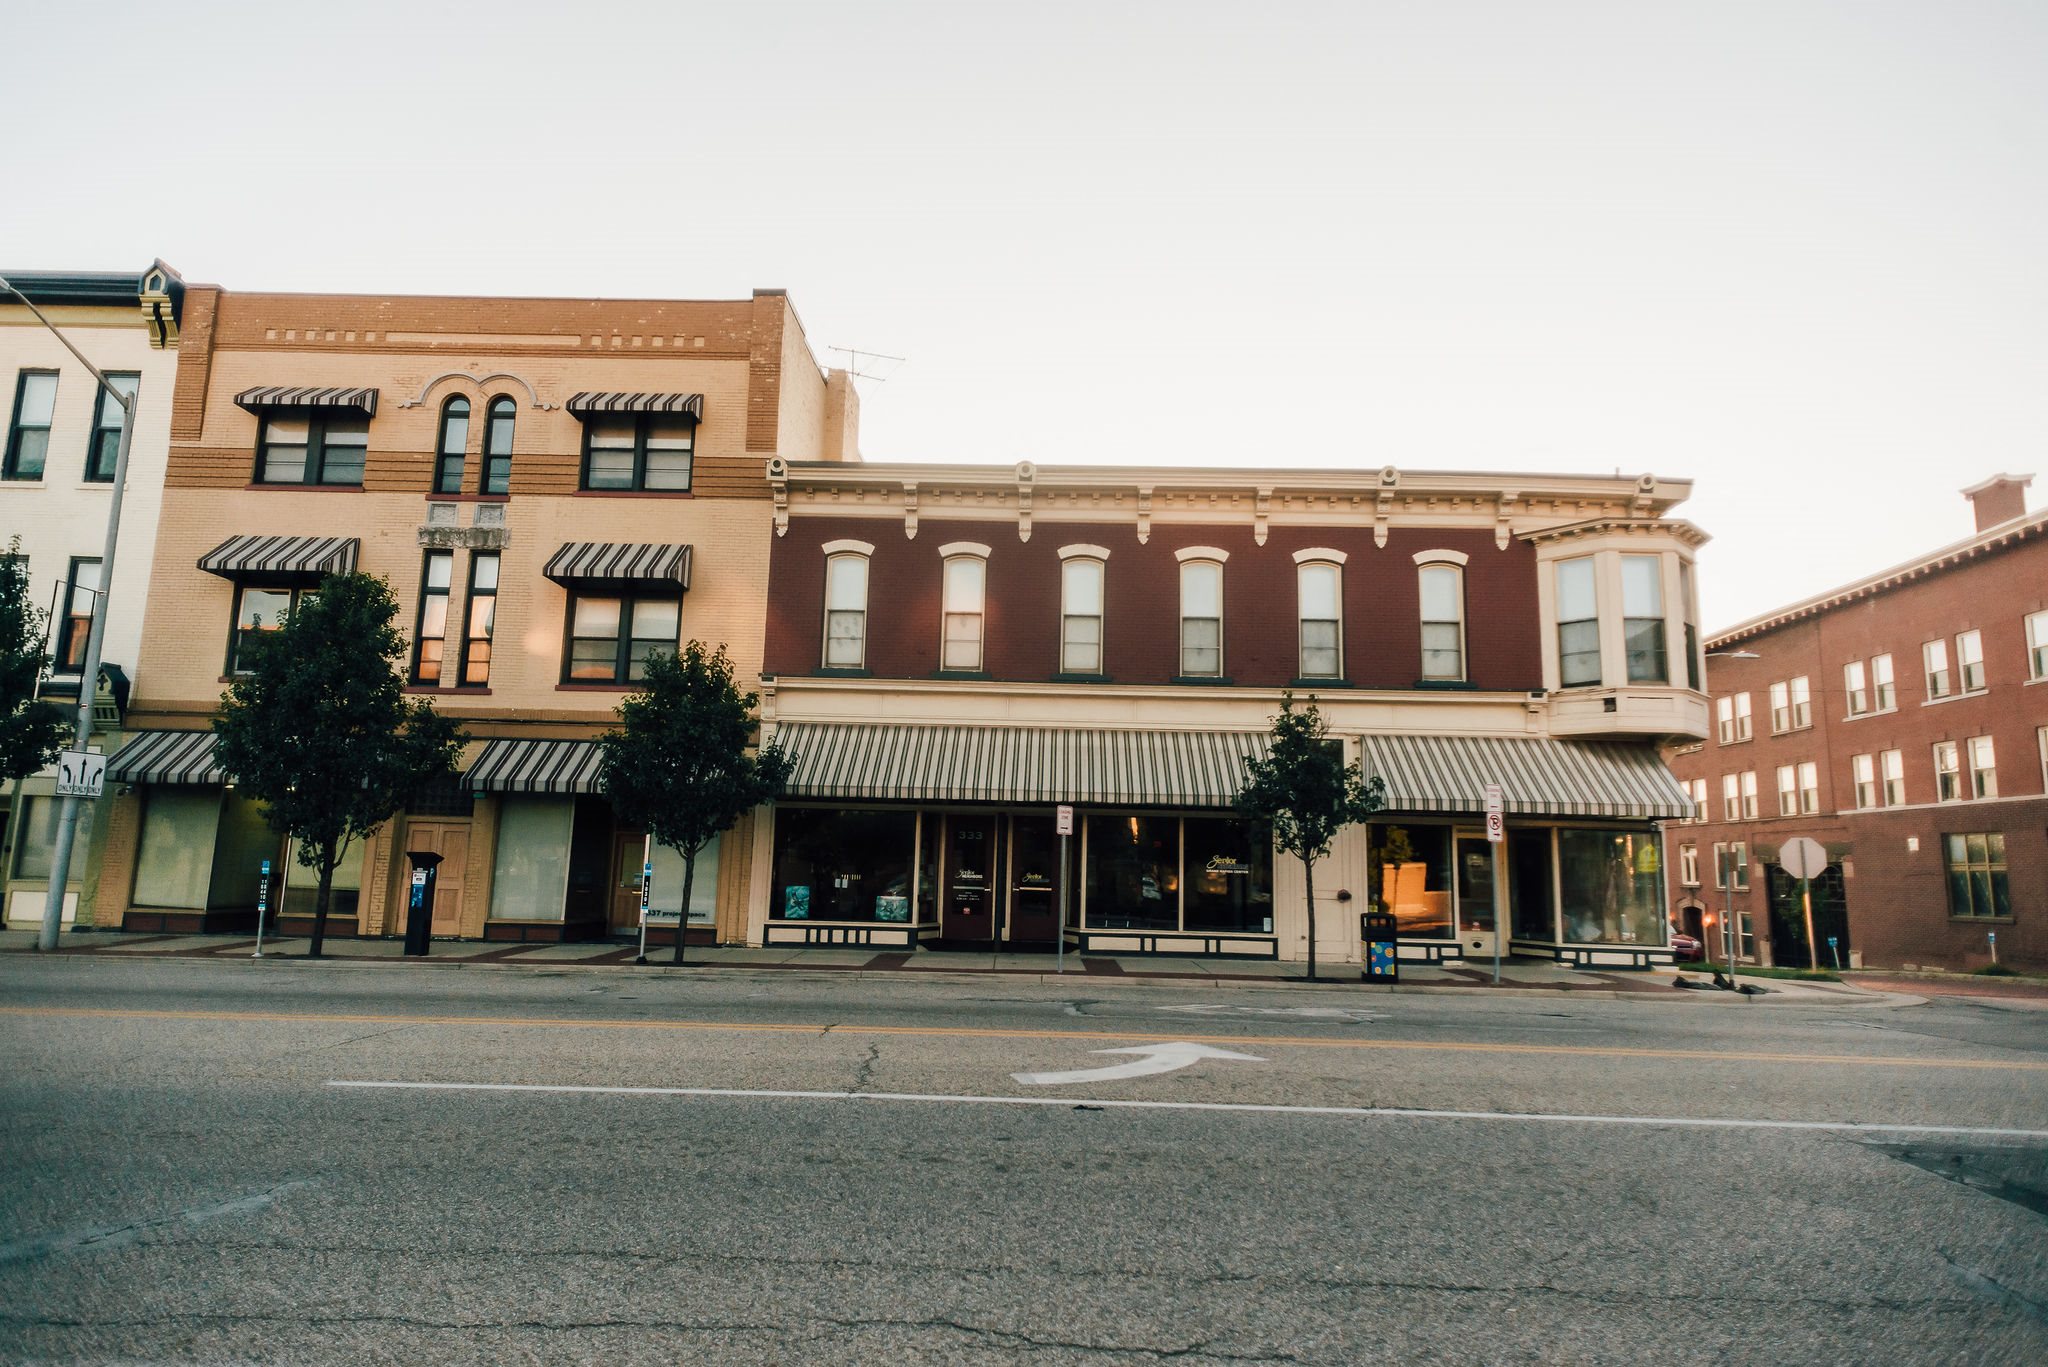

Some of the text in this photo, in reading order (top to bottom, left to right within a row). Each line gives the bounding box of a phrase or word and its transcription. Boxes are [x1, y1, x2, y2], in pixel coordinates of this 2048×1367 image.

[58, 784, 101, 794] ONLY ONLY ONLY
[959, 831, 983, 840] 333
[1206, 855, 1237, 868] Senior
